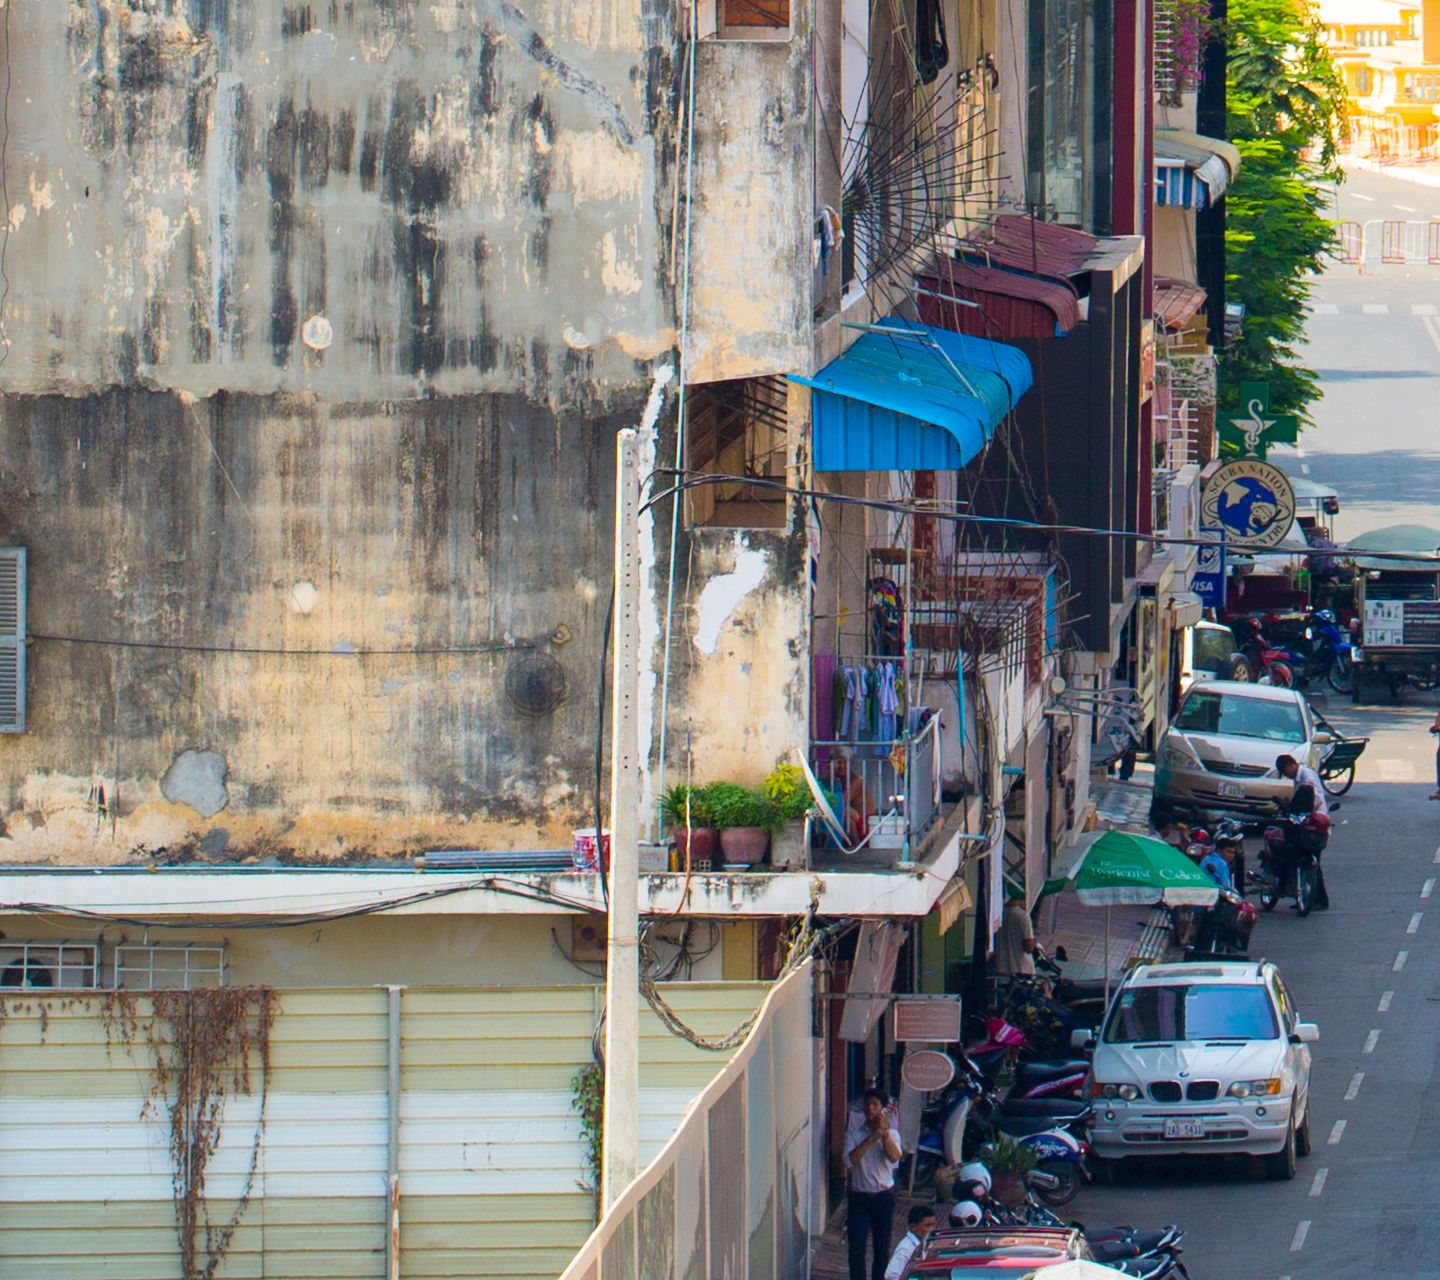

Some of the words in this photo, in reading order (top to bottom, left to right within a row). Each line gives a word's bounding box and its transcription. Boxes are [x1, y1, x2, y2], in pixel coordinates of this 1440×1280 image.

[1210, 465, 1244, 495] SCUBA
[1249, 464, 1288, 498] NATION
[1191, 581, 1214, 592] VISA
